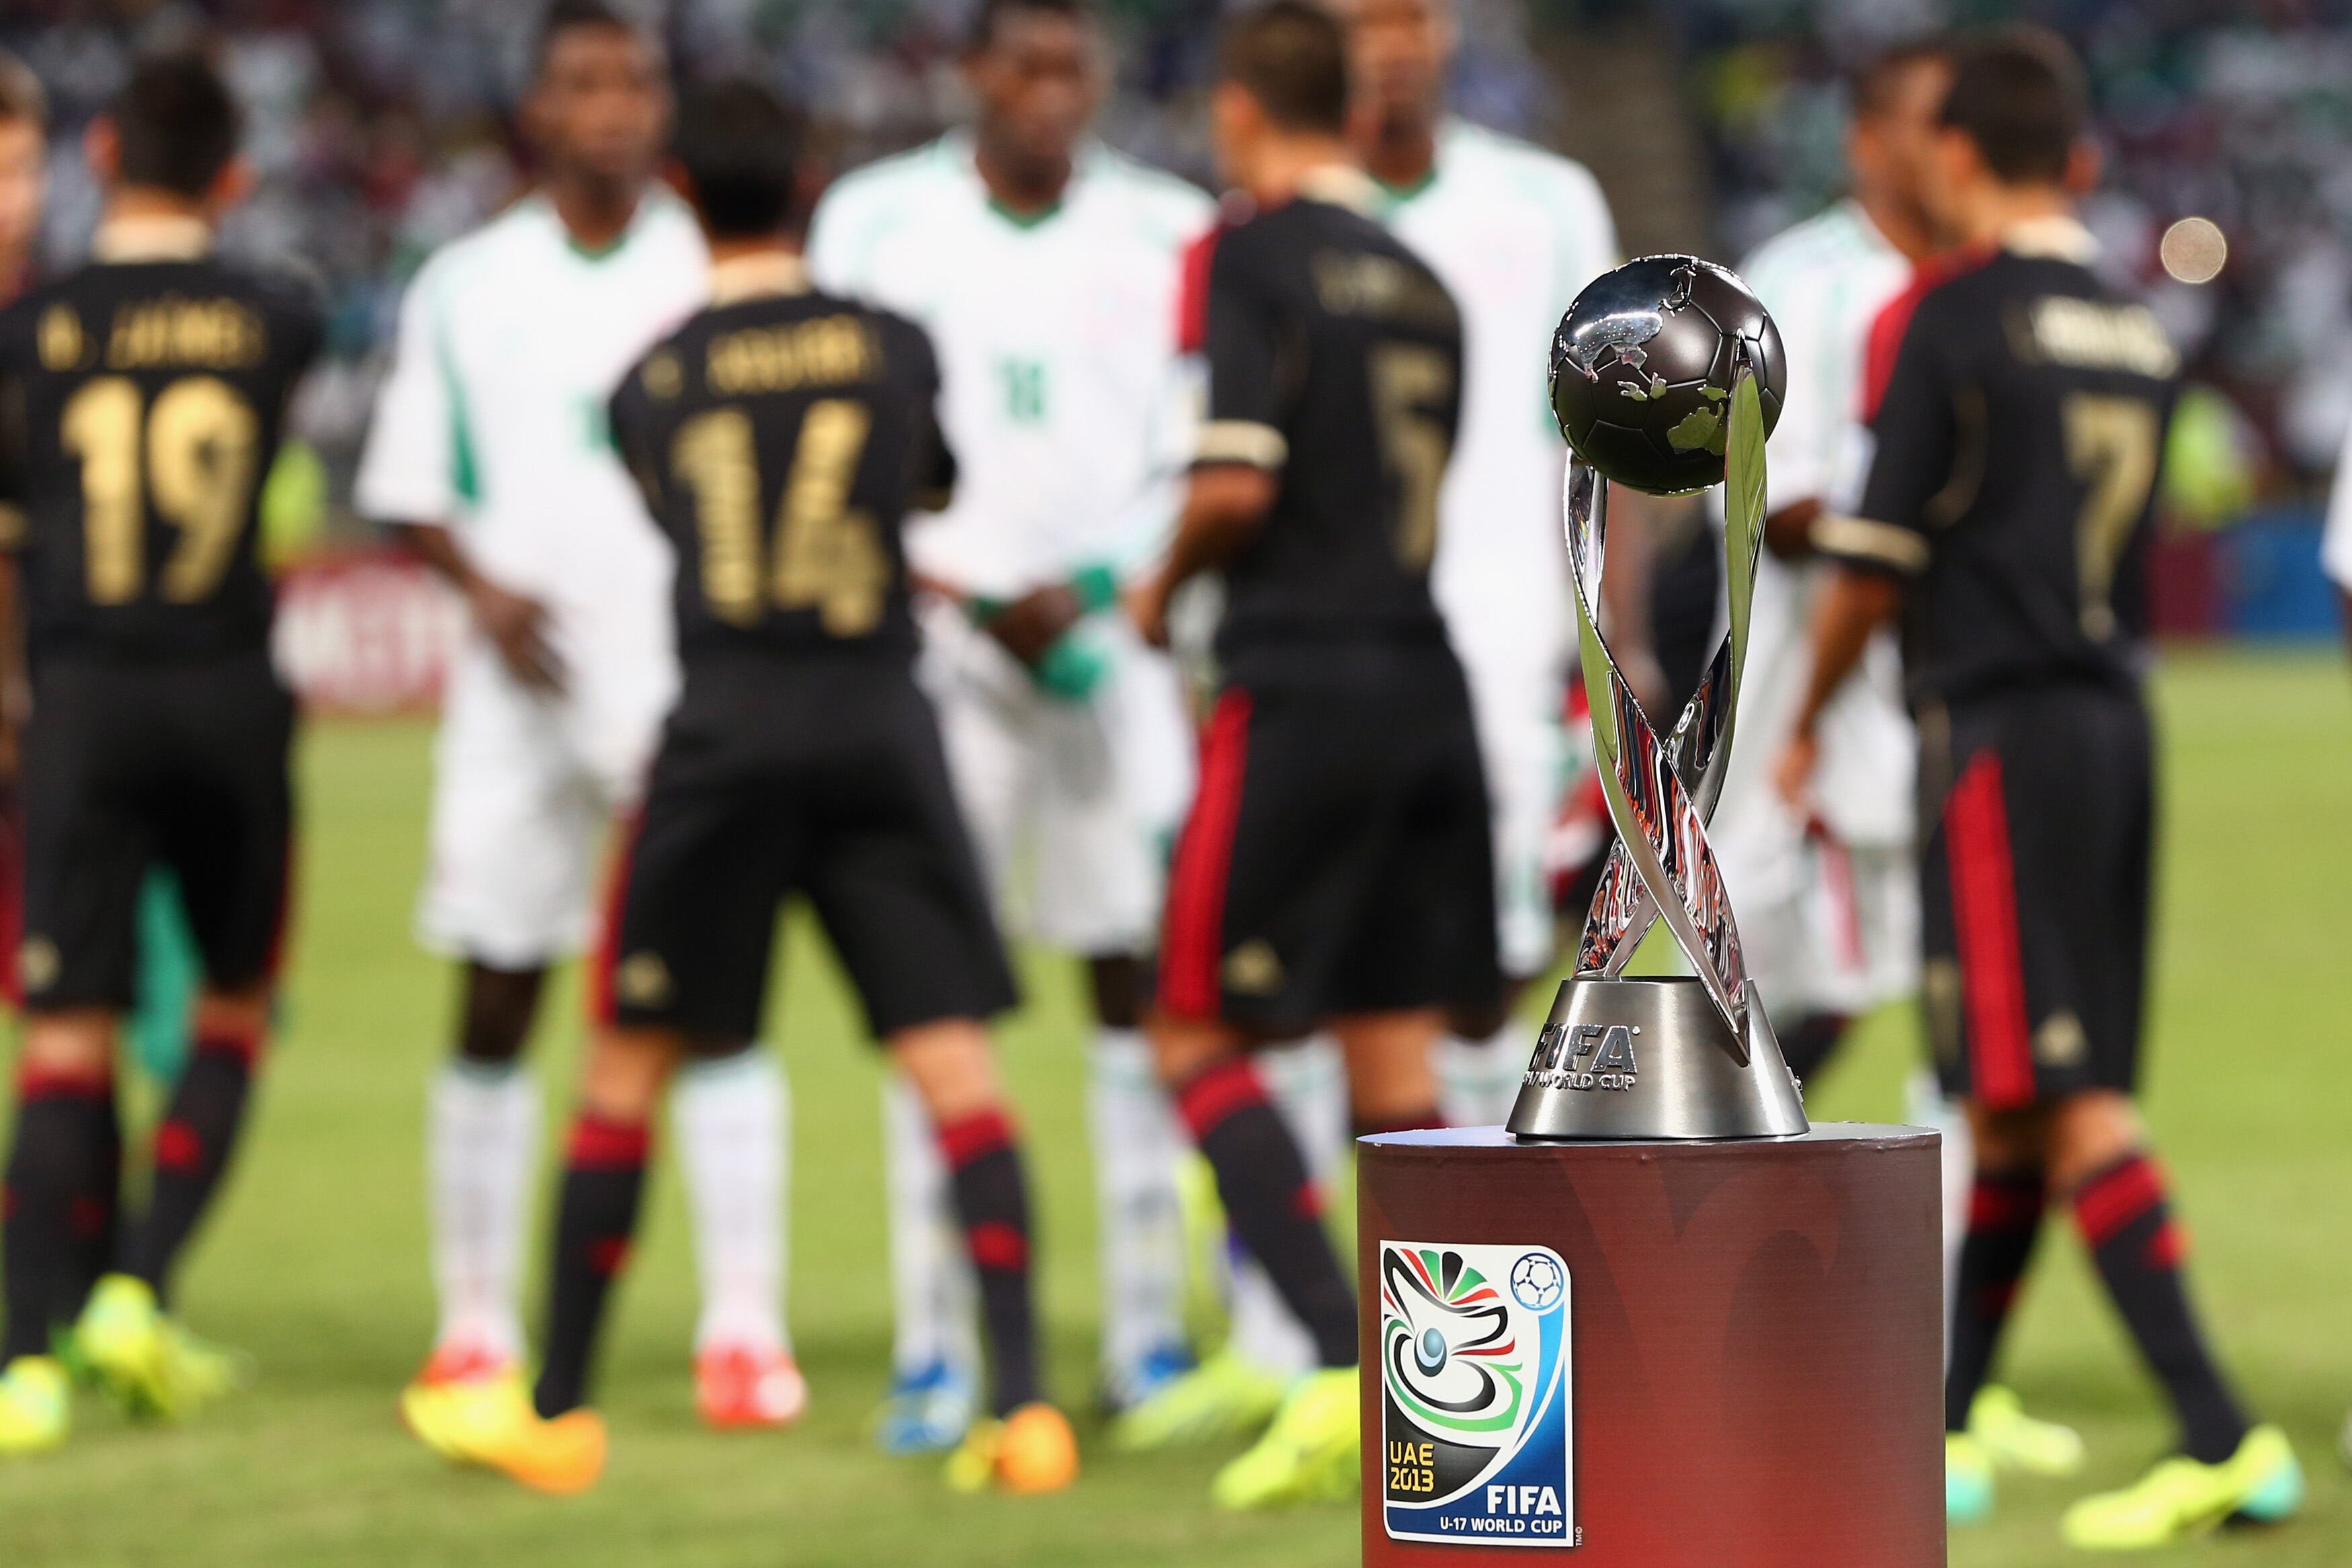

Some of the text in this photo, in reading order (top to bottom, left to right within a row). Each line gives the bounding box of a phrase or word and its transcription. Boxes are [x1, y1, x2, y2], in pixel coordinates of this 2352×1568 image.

[1368, 340, 1453, 576] 5
[60, 374, 259, 606] 19
[669, 398, 890, 640] 14
[2062, 388, 2164, 644] 7
[1529, 1023, 1638, 1074] FIFA
[1538, 1071, 1594, 1090] WORLD
[1599, 1074, 1636, 1092] CUP
[1389, 1440, 1435, 1467] UAE
[1390, 1466, 1435, 1493] 2013
[1486, 1485, 1563, 1516] FIFA
[1439, 1516, 1564, 1534] U-17 WORLD CUP
